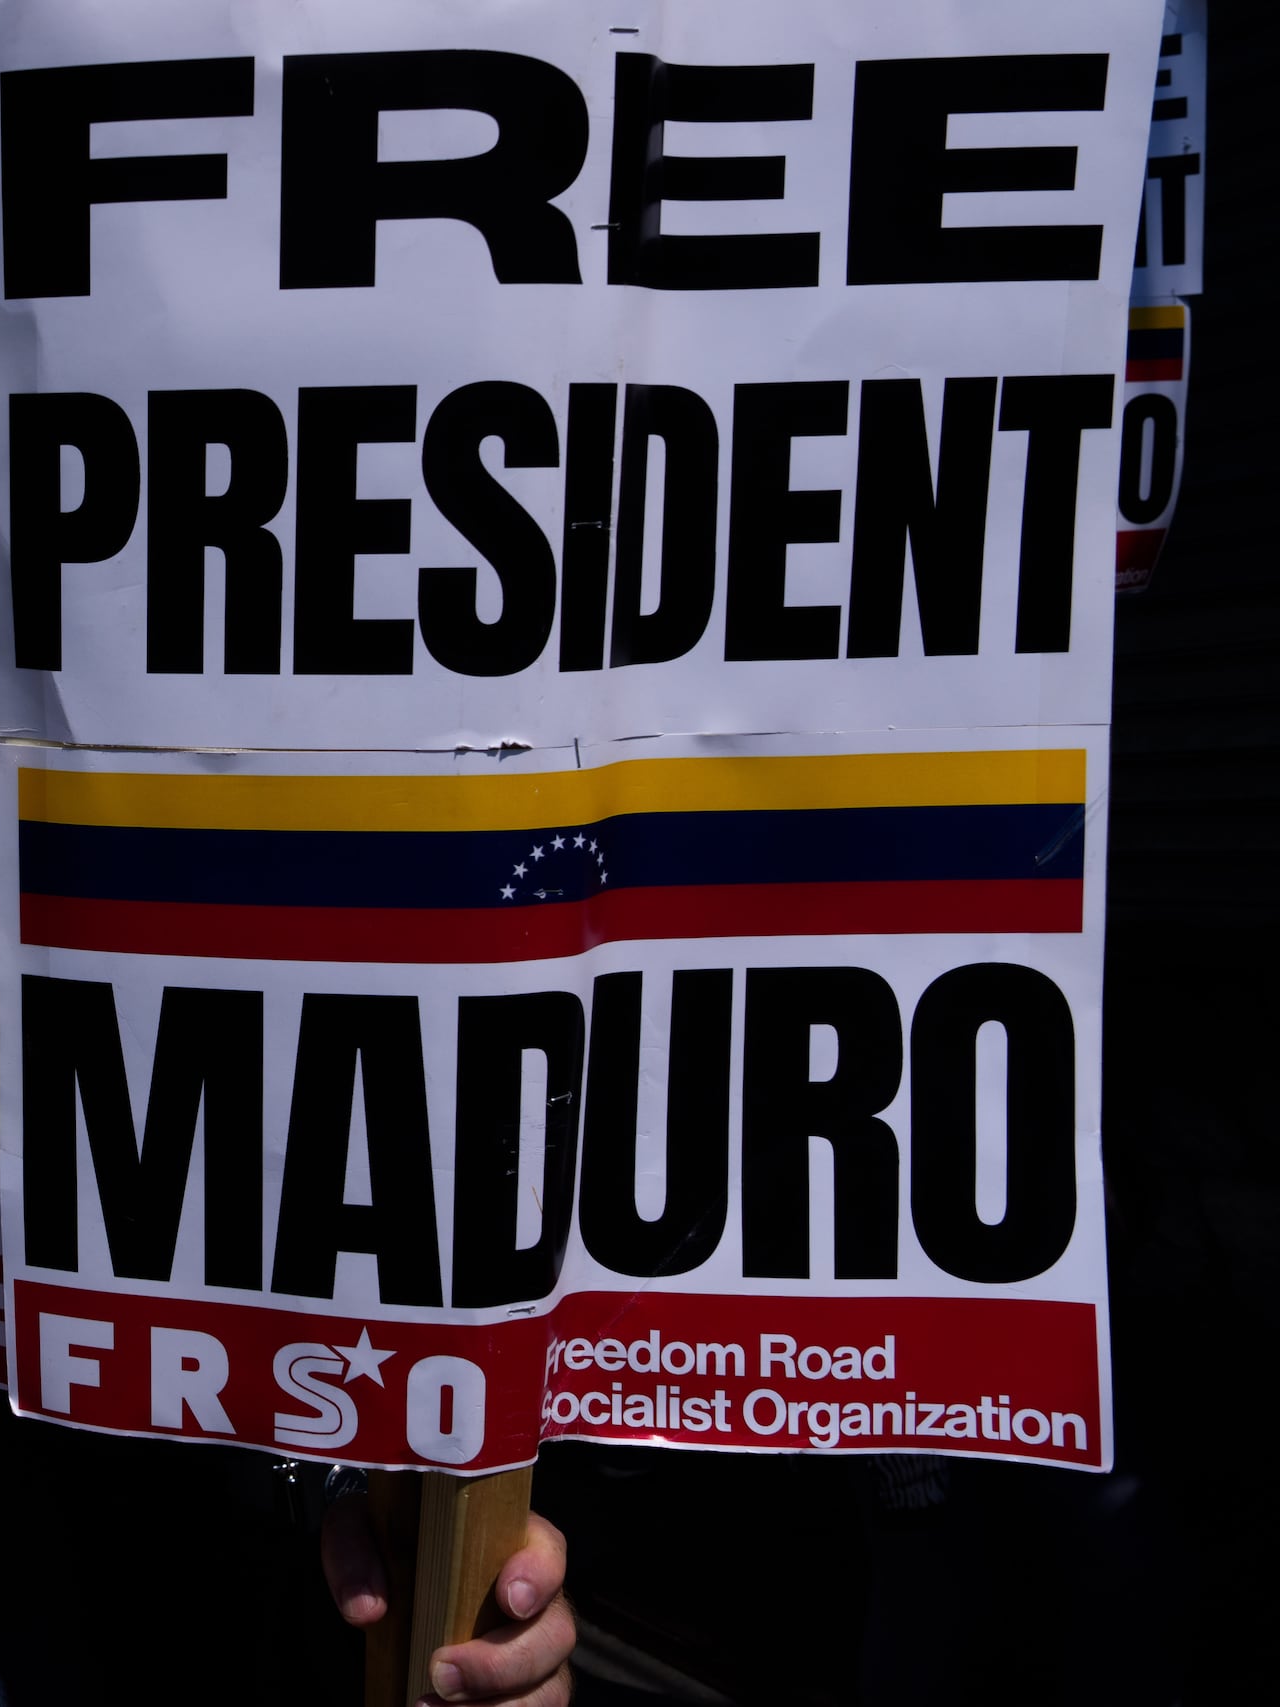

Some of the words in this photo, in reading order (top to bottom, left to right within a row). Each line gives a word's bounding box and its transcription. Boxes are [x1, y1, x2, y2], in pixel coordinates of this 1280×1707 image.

[0, 49, 1109, 299] FREE
[10, 373, 1115, 677] PRESIDENT
[22, 963, 1076, 1308] MADURO
[38, 1311, 487, 1465] FRSO
[742, 1388, 1088, 1450] Organization
[759, 1333, 896, 1382] Road
